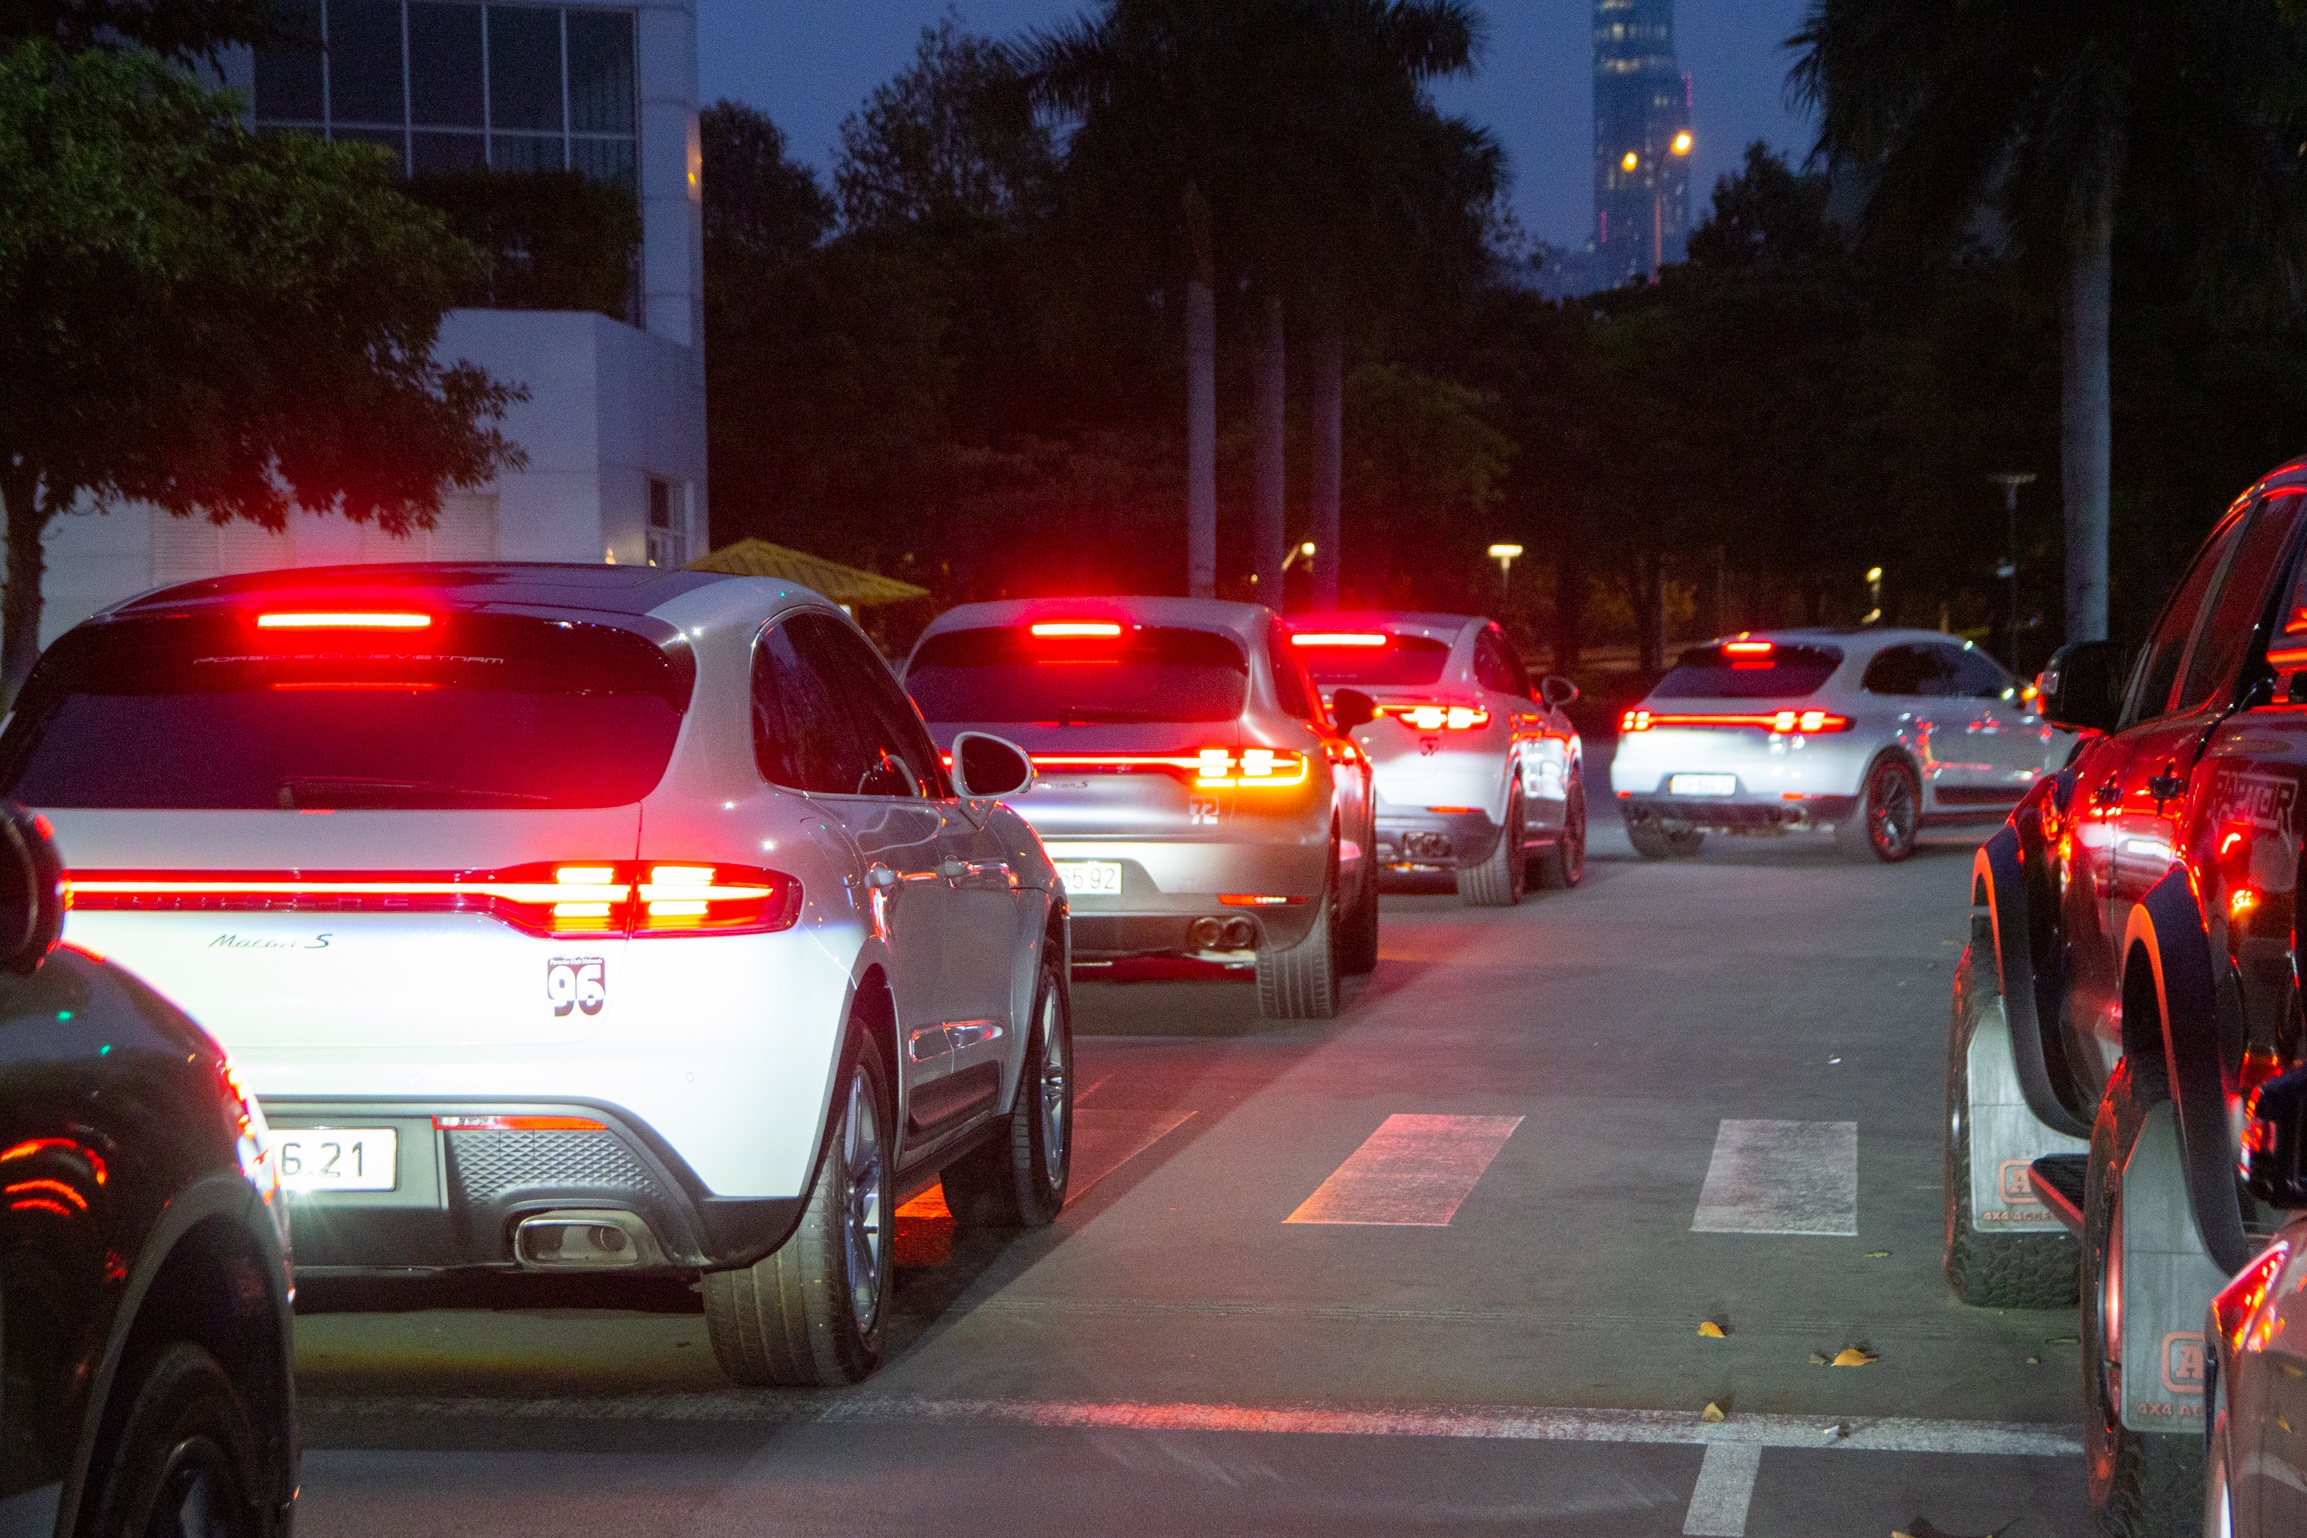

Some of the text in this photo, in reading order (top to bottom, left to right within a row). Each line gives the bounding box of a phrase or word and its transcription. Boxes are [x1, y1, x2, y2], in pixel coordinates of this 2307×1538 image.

[1191, 797, 1219, 825] 72
[208, 933, 333, 948] Macan S
[547, 964, 606, 1017] 96
